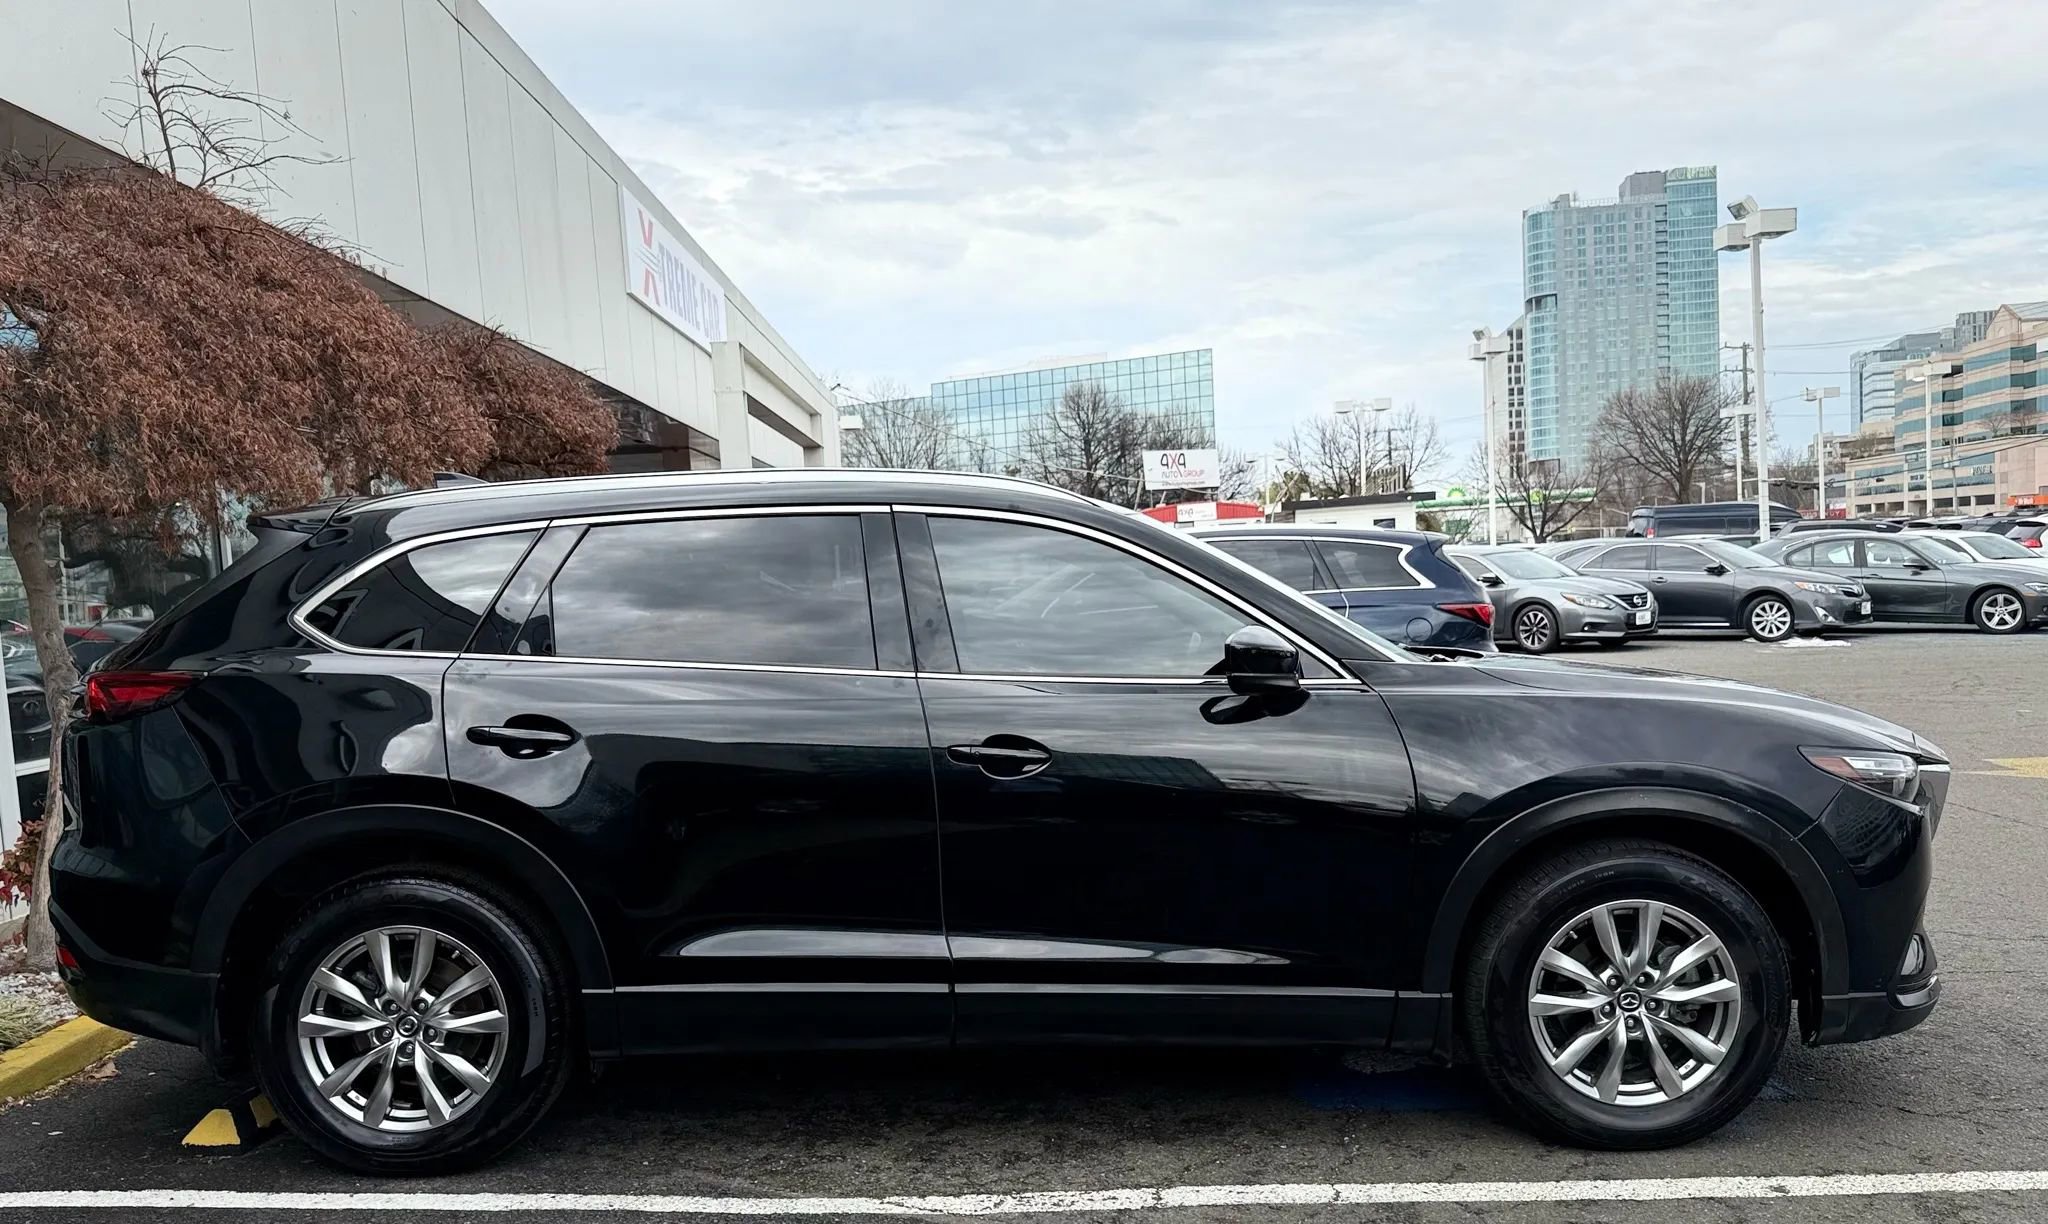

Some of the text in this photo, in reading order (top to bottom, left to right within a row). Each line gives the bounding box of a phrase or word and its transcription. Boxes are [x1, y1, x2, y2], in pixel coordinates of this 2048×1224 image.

[700, 282, 721, 342] CAR
[1161, 469, 1205, 479] AUTO GROUP
